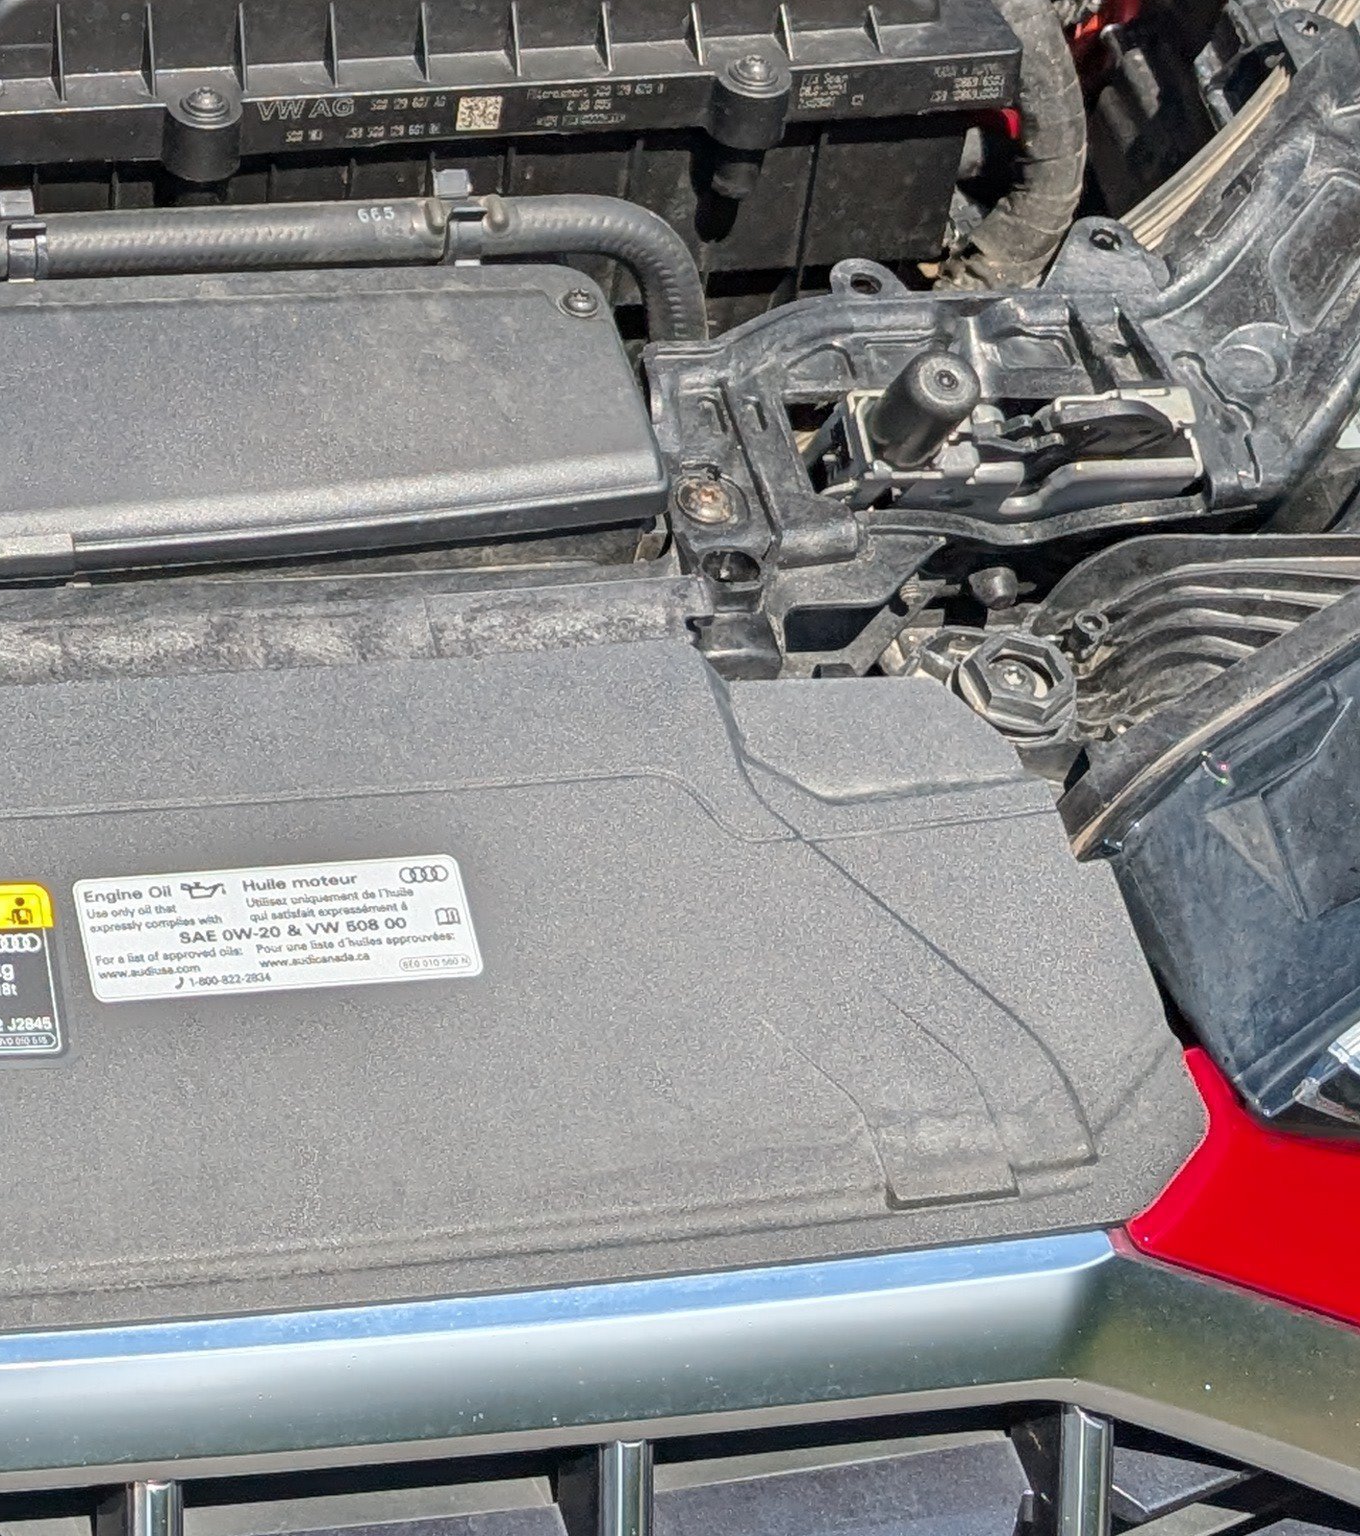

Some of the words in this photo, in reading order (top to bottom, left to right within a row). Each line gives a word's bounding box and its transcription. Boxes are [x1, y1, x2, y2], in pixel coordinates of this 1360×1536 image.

[257, 99, 305, 122] VW
[308, 98, 354, 118] AG
[242, 878, 287, 893] Huile
[292, 873, 358, 889] moteur
[84, 889, 143, 905] Engine
[149, 886, 173, 899] Oil
[246, 896, 287, 909] Utilisez
[291, 892, 359, 907] uniquement
[362, 889, 377, 900] de
[86, 908, 109, 920] Use
[111, 905, 136, 919] only
[139, 905, 153, 916] oil
[155, 903, 177, 915] that
[249, 911, 269, 924] qui
[271, 907, 316, 921] satisfait
[90, 919, 143, 934] expressly
[145, 916, 196, 931] complies
[197, 914, 223, 926] with
[179, 930, 218, 944] SAE
[222, 925, 281, 941] 0W-20
[286, 924, 303, 938] &
[307, 921, 341, 936] VW
[345, 918, 380, 934] 508
[385, 917, 408, 930] 00
[95, 955, 115, 967] For
[117, 955, 126, 965] a
[128, 951, 146, 963] list
[148, 949, 160, 961] of
[163, 945, 216, 962] approved
[256, 942, 286, 955] Pour
[288, 941, 308, 953] une
[311, 938, 336, 951] liste
[259, 952, 370, 969] www.audicanada.ca
[98, 962, 202, 980] www.audiusa.com
[7, 1016, 52, 1031] J2845
